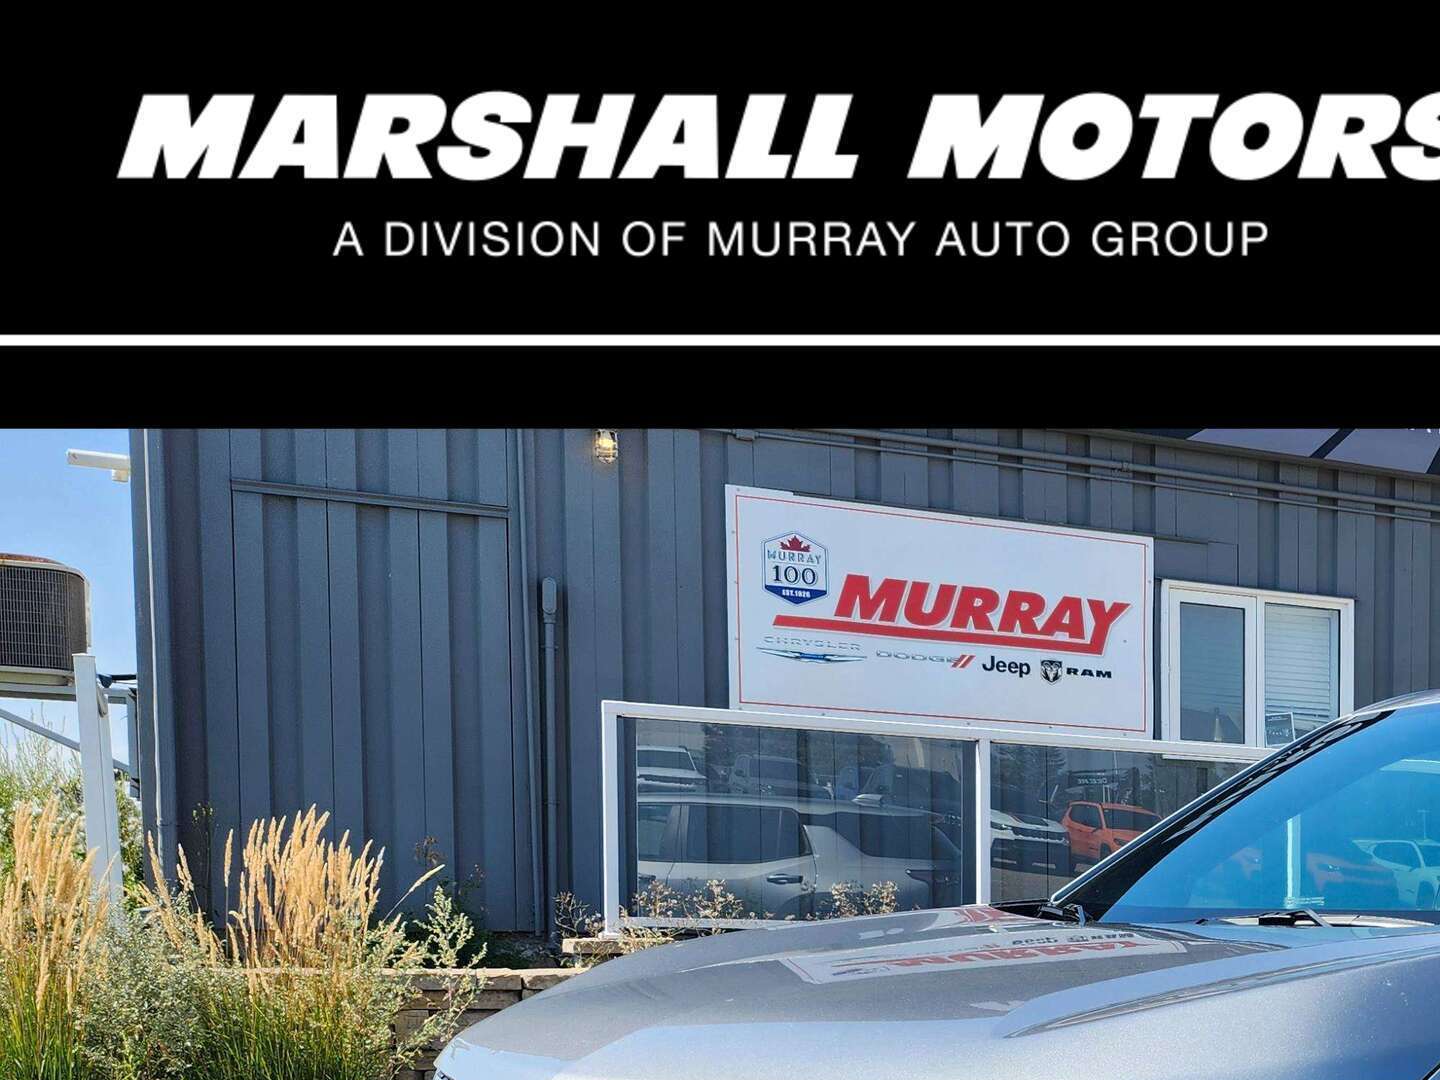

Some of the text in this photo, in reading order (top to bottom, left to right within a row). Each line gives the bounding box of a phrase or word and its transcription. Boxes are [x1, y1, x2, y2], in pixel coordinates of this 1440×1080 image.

[767, 550, 822, 565] MURRAY
[772, 565, 818, 586] 100
[834, 573, 1132, 645] MURRAY
[982, 655, 1032, 679] Jeep
[1066, 667, 1113, 680] RAM
